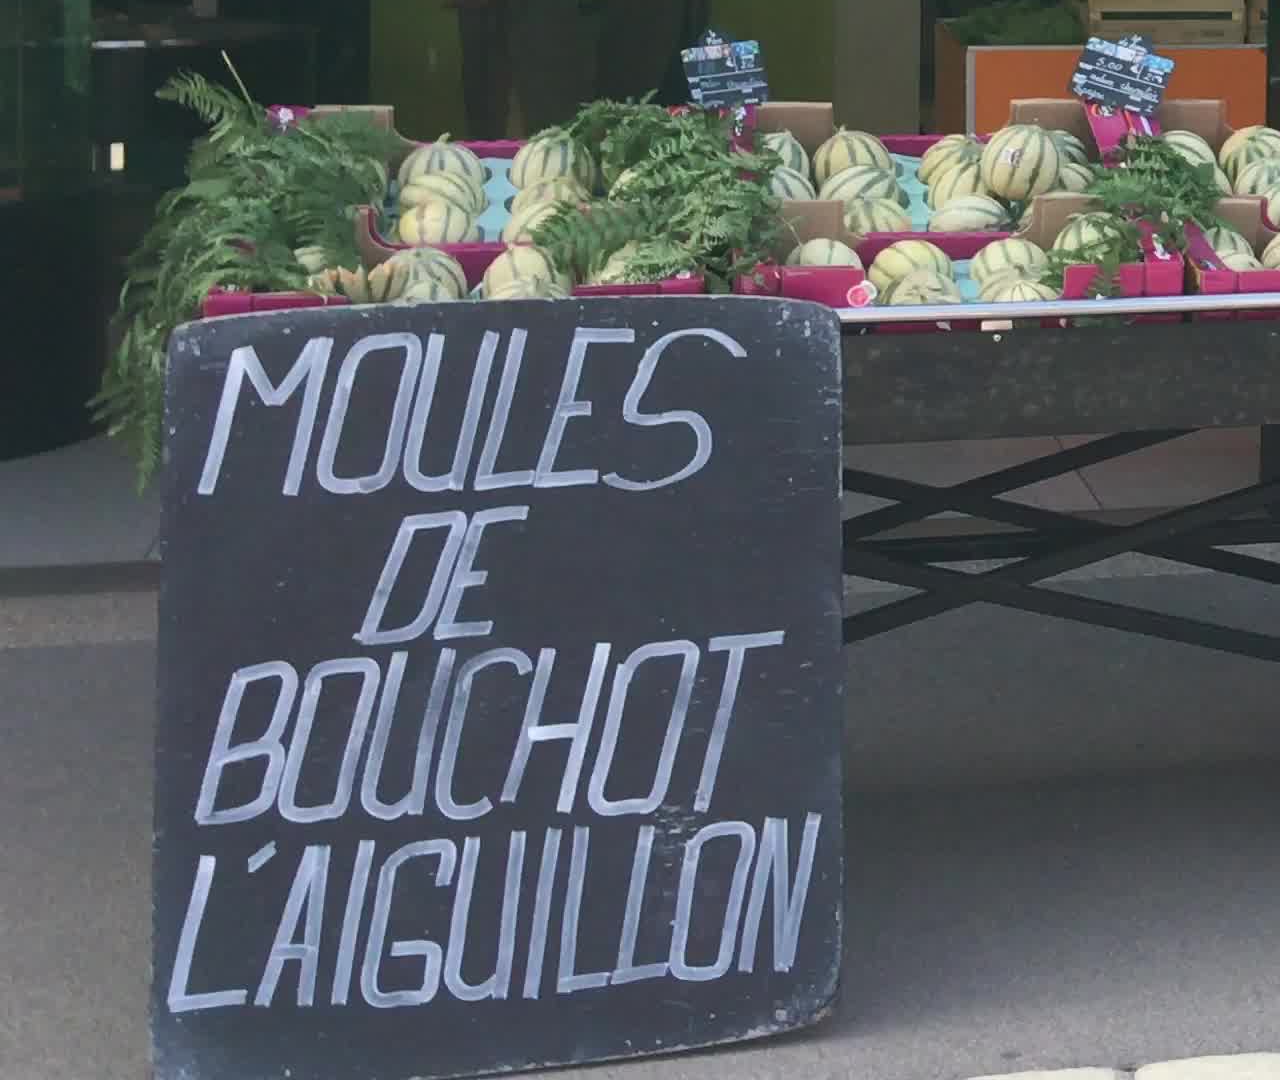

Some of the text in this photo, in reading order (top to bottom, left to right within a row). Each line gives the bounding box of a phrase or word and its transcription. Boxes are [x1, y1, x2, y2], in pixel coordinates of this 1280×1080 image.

[197, 326, 748, 496] MOULES
[353, 505, 530, 645] DE
[193, 630, 786, 826] BOUCHOT
[167, 812, 822, 1013] L'AIGUILLON
